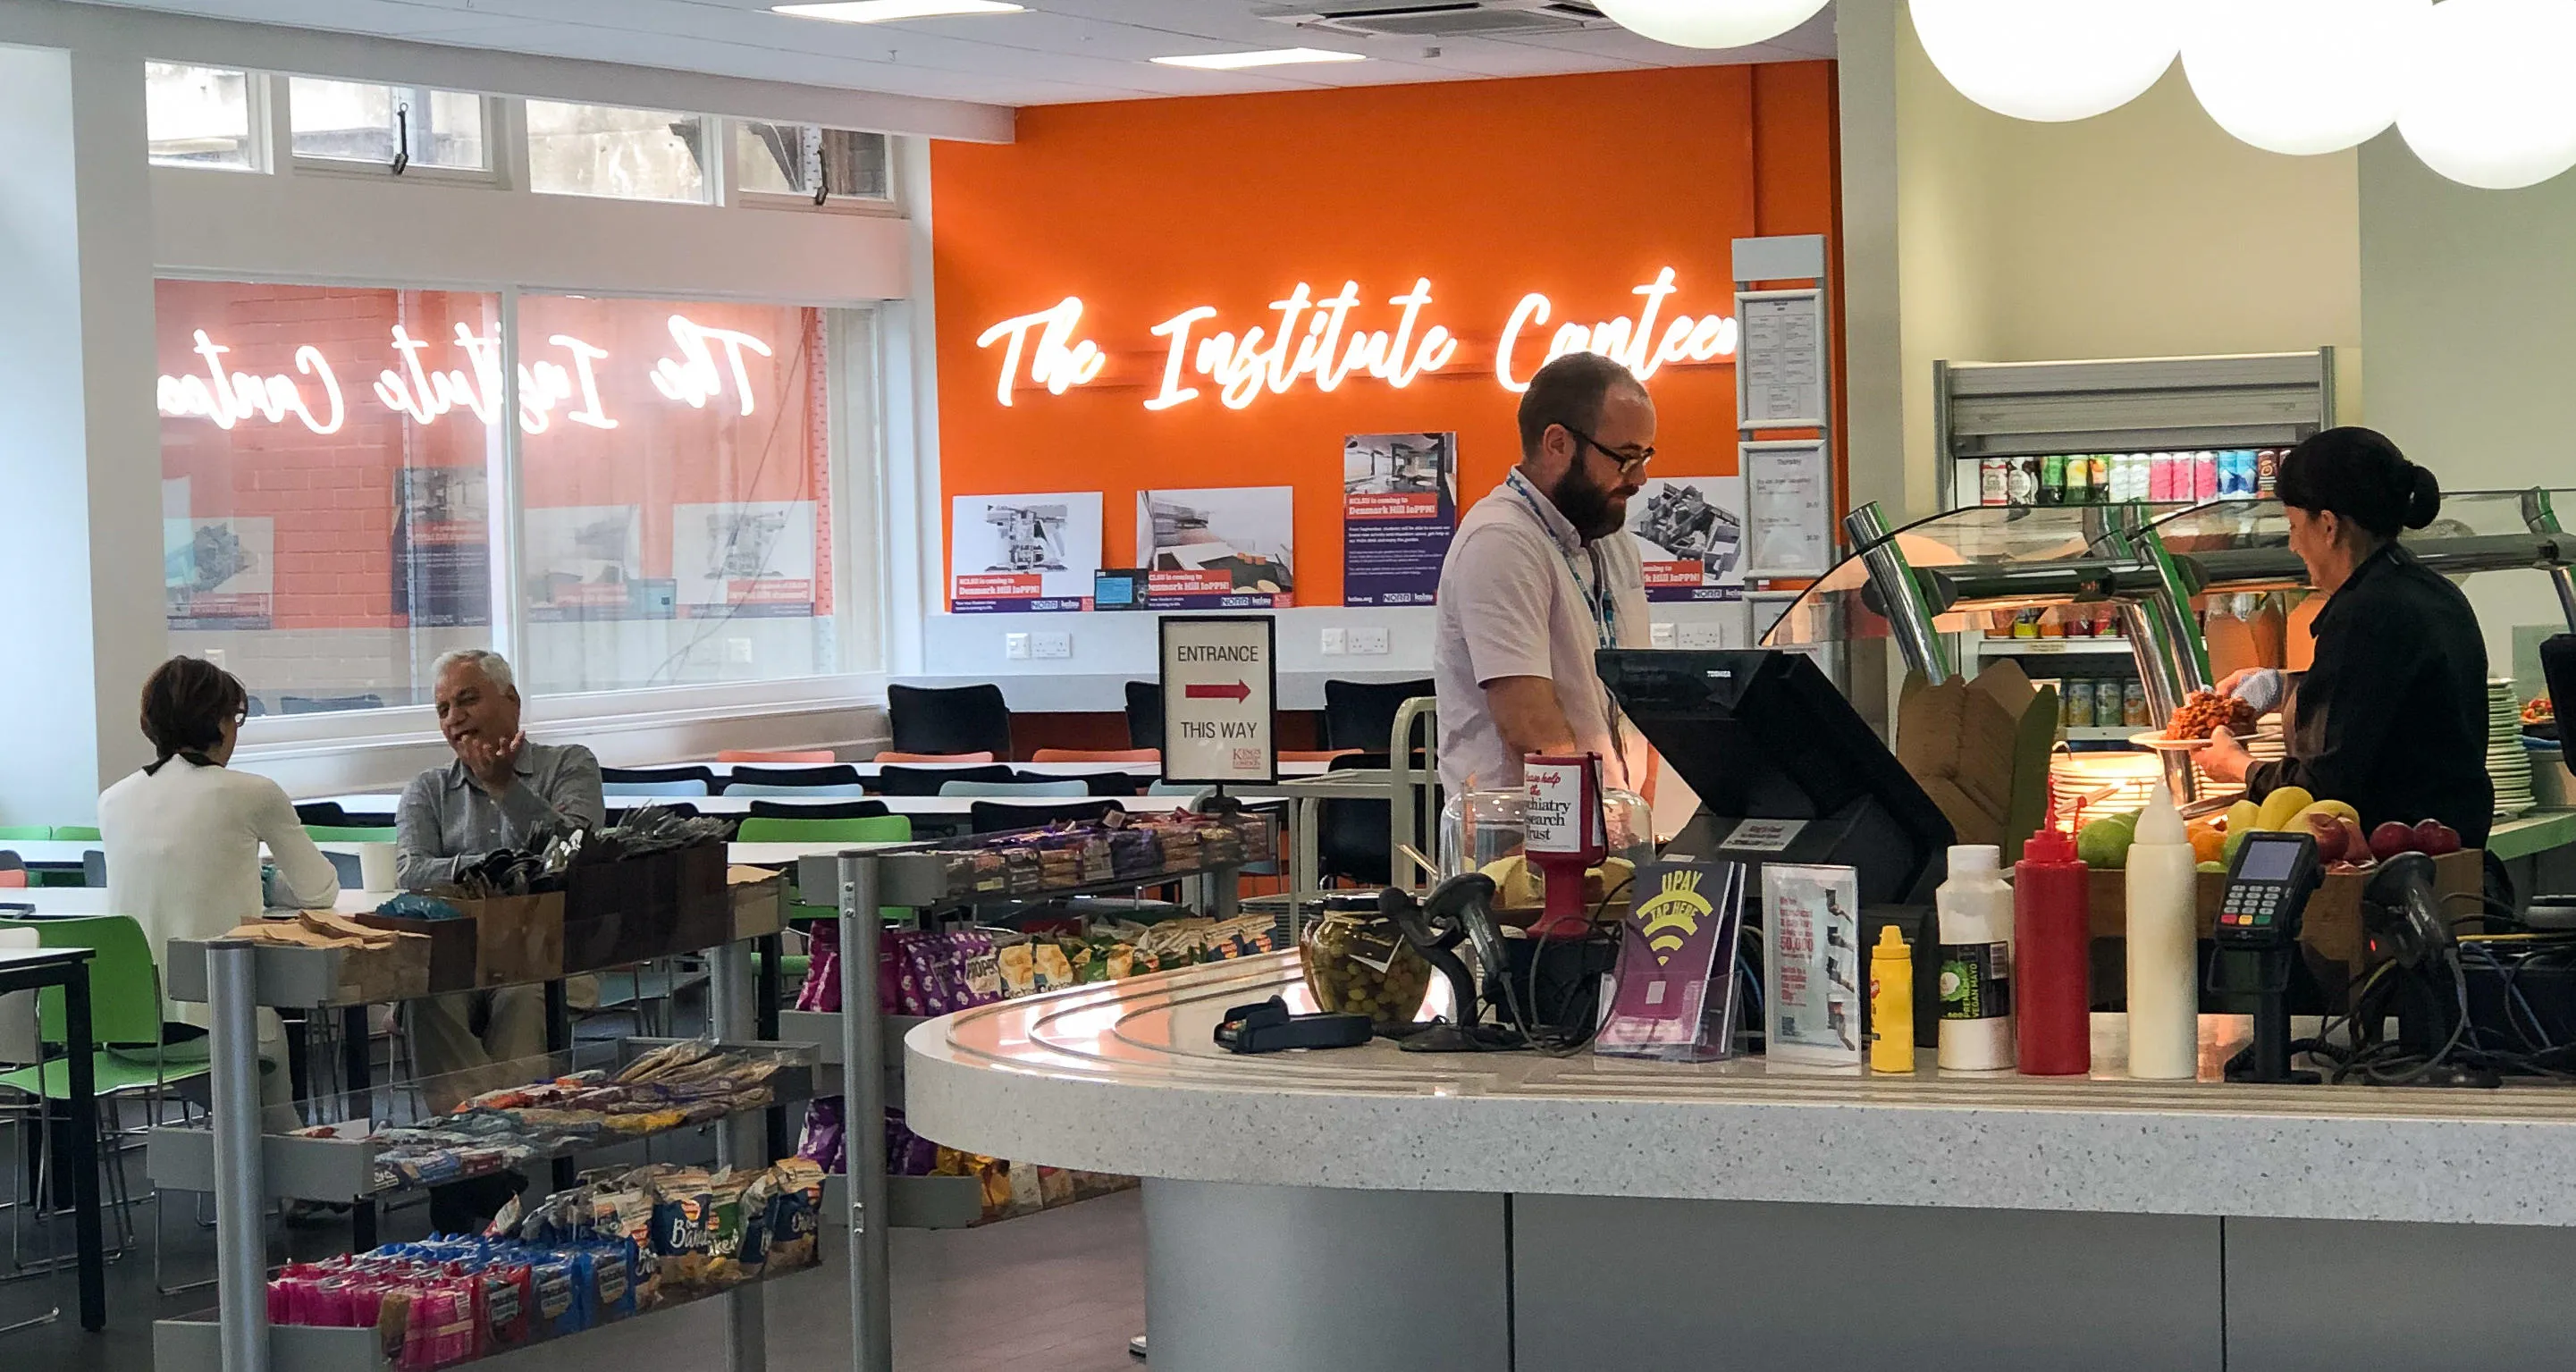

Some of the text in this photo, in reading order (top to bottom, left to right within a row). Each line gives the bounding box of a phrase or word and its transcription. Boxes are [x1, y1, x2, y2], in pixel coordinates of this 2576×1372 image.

[977, 297, 1106, 407] The
[1143, 277, 1457, 410] Institute
[1349, 507, 1389, 515] Denmark
[959, 585, 996, 595] Denmark
[1177, 645, 1259, 661] ENTRANCE
[1181, 721, 1258, 738] THIS WAY
[1541, 772, 1562, 788] help
[1529, 785, 1541, 795] the
[1662, 870, 1703, 892] UPAY
[1650, 900, 1698, 920] TAP HERE
[1969, 964, 1980, 1018] VEGAN MAYO
